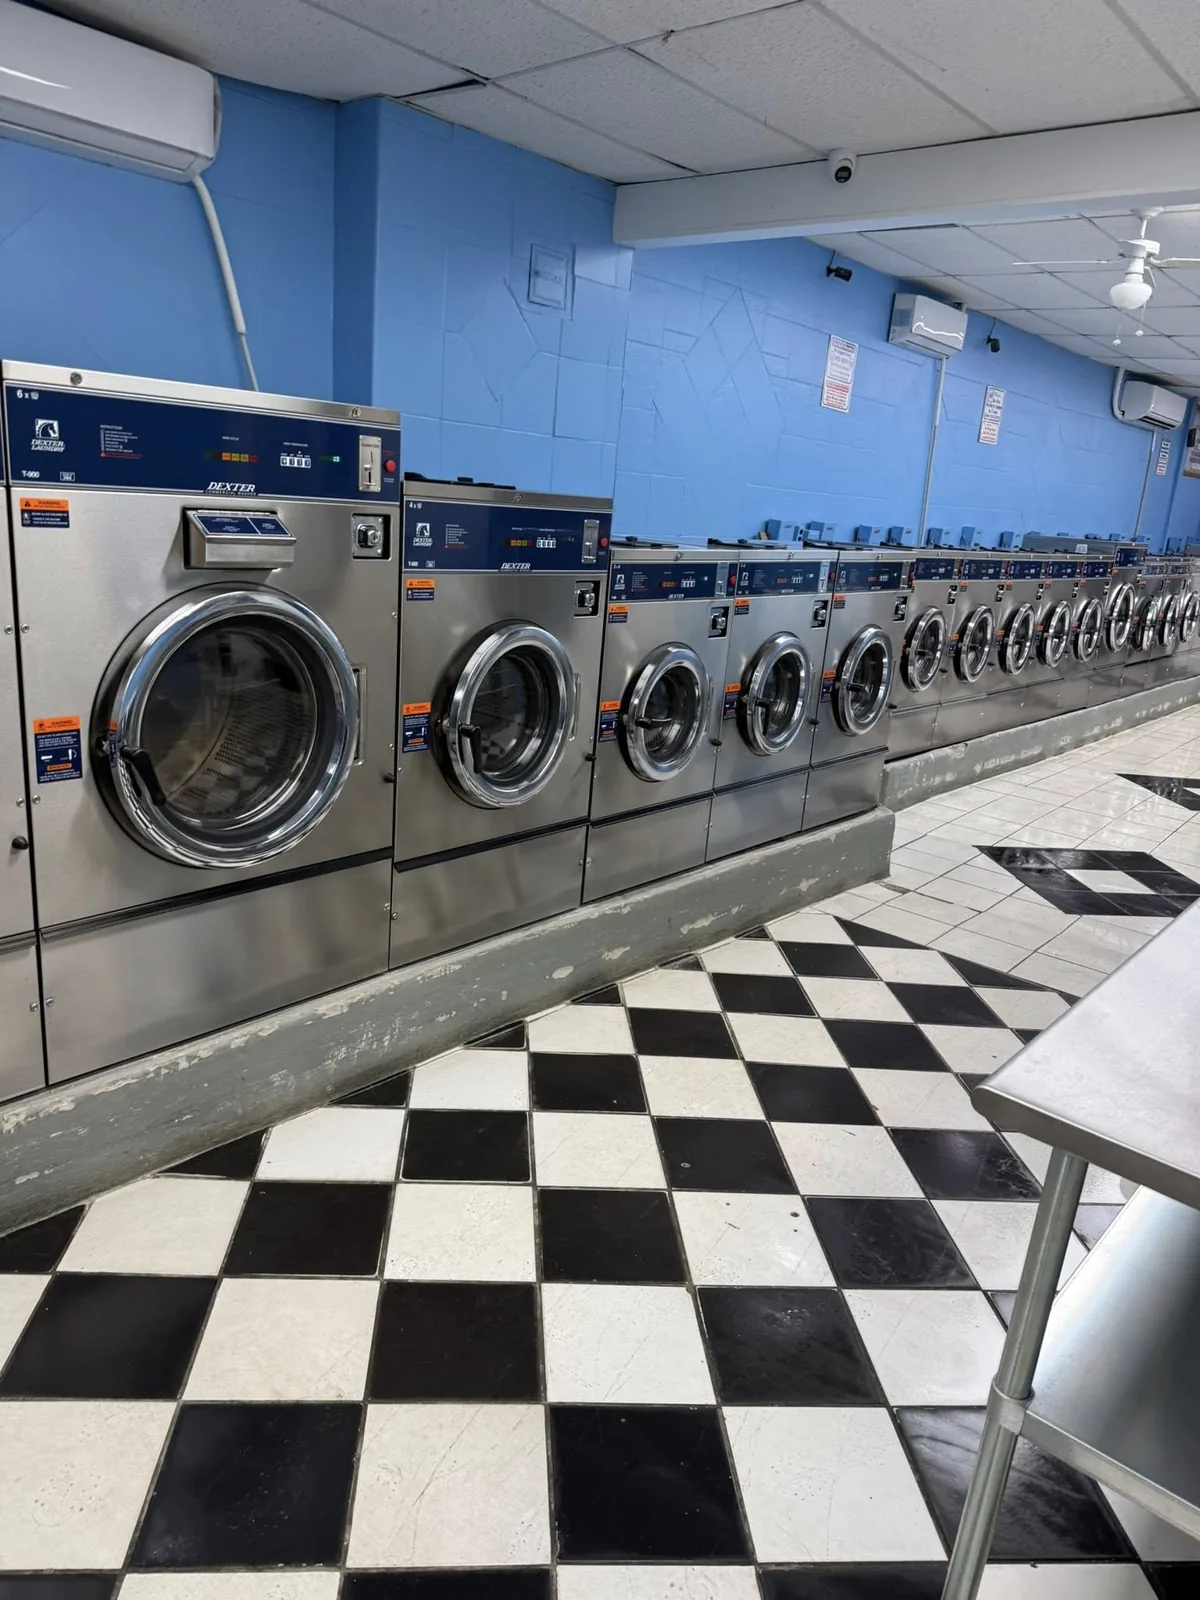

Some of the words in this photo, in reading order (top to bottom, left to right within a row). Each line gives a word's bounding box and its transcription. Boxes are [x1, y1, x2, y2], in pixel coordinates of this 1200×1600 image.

[16, 389, 23, 399] 6
[30, 438, 66, 448] DEXTER
[30, 444, 66, 453] LAUNDRY
[207, 481, 256, 493] DEXTER
[500, 562, 531, 570] DEXTER
